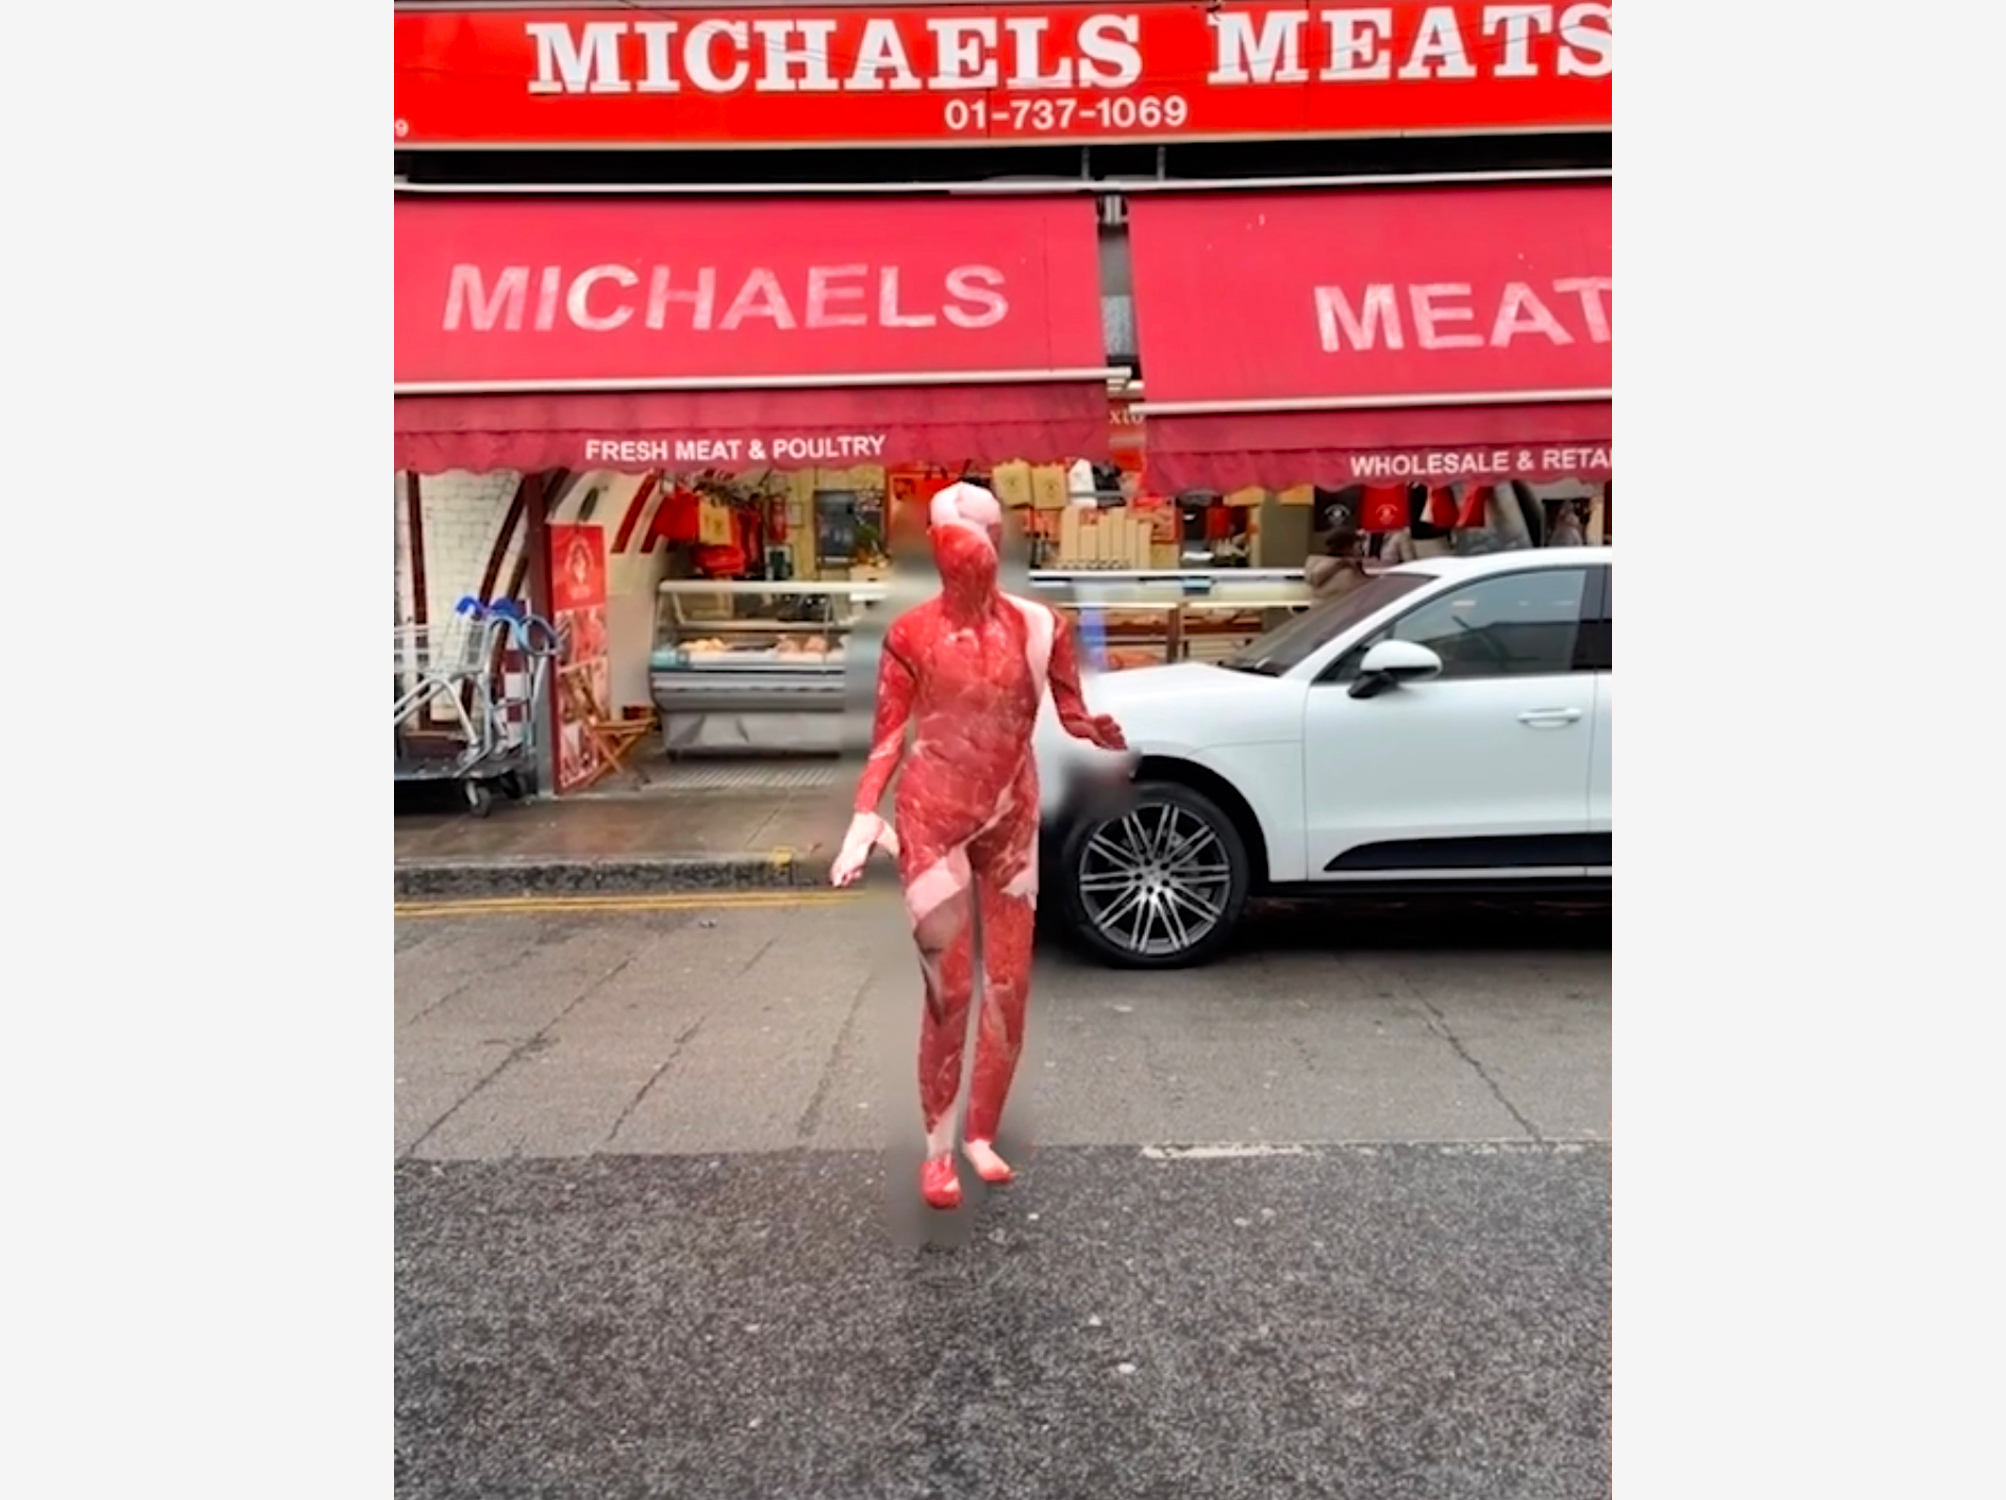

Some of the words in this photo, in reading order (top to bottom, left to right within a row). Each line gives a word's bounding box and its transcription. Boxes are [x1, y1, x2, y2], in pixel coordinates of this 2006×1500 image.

[526, 16, 1142, 92] MICHAELS
[1206, 2, 1612, 85] MEATS
[943, 95, 1188, 130] 01-737-1069
[442, 263, 1011, 331] MICHAELS
[1313, 276, 1612, 352] MEAT
[585, 439, 667, 462] FRESH
[675, 439, 742, 461] MEAT
[748, 440, 766, 460] &
[772, 435, 886, 460] POULTRY
[1351, 451, 1510, 477] WHOLESALE
[1516, 451, 1535, 471] &
